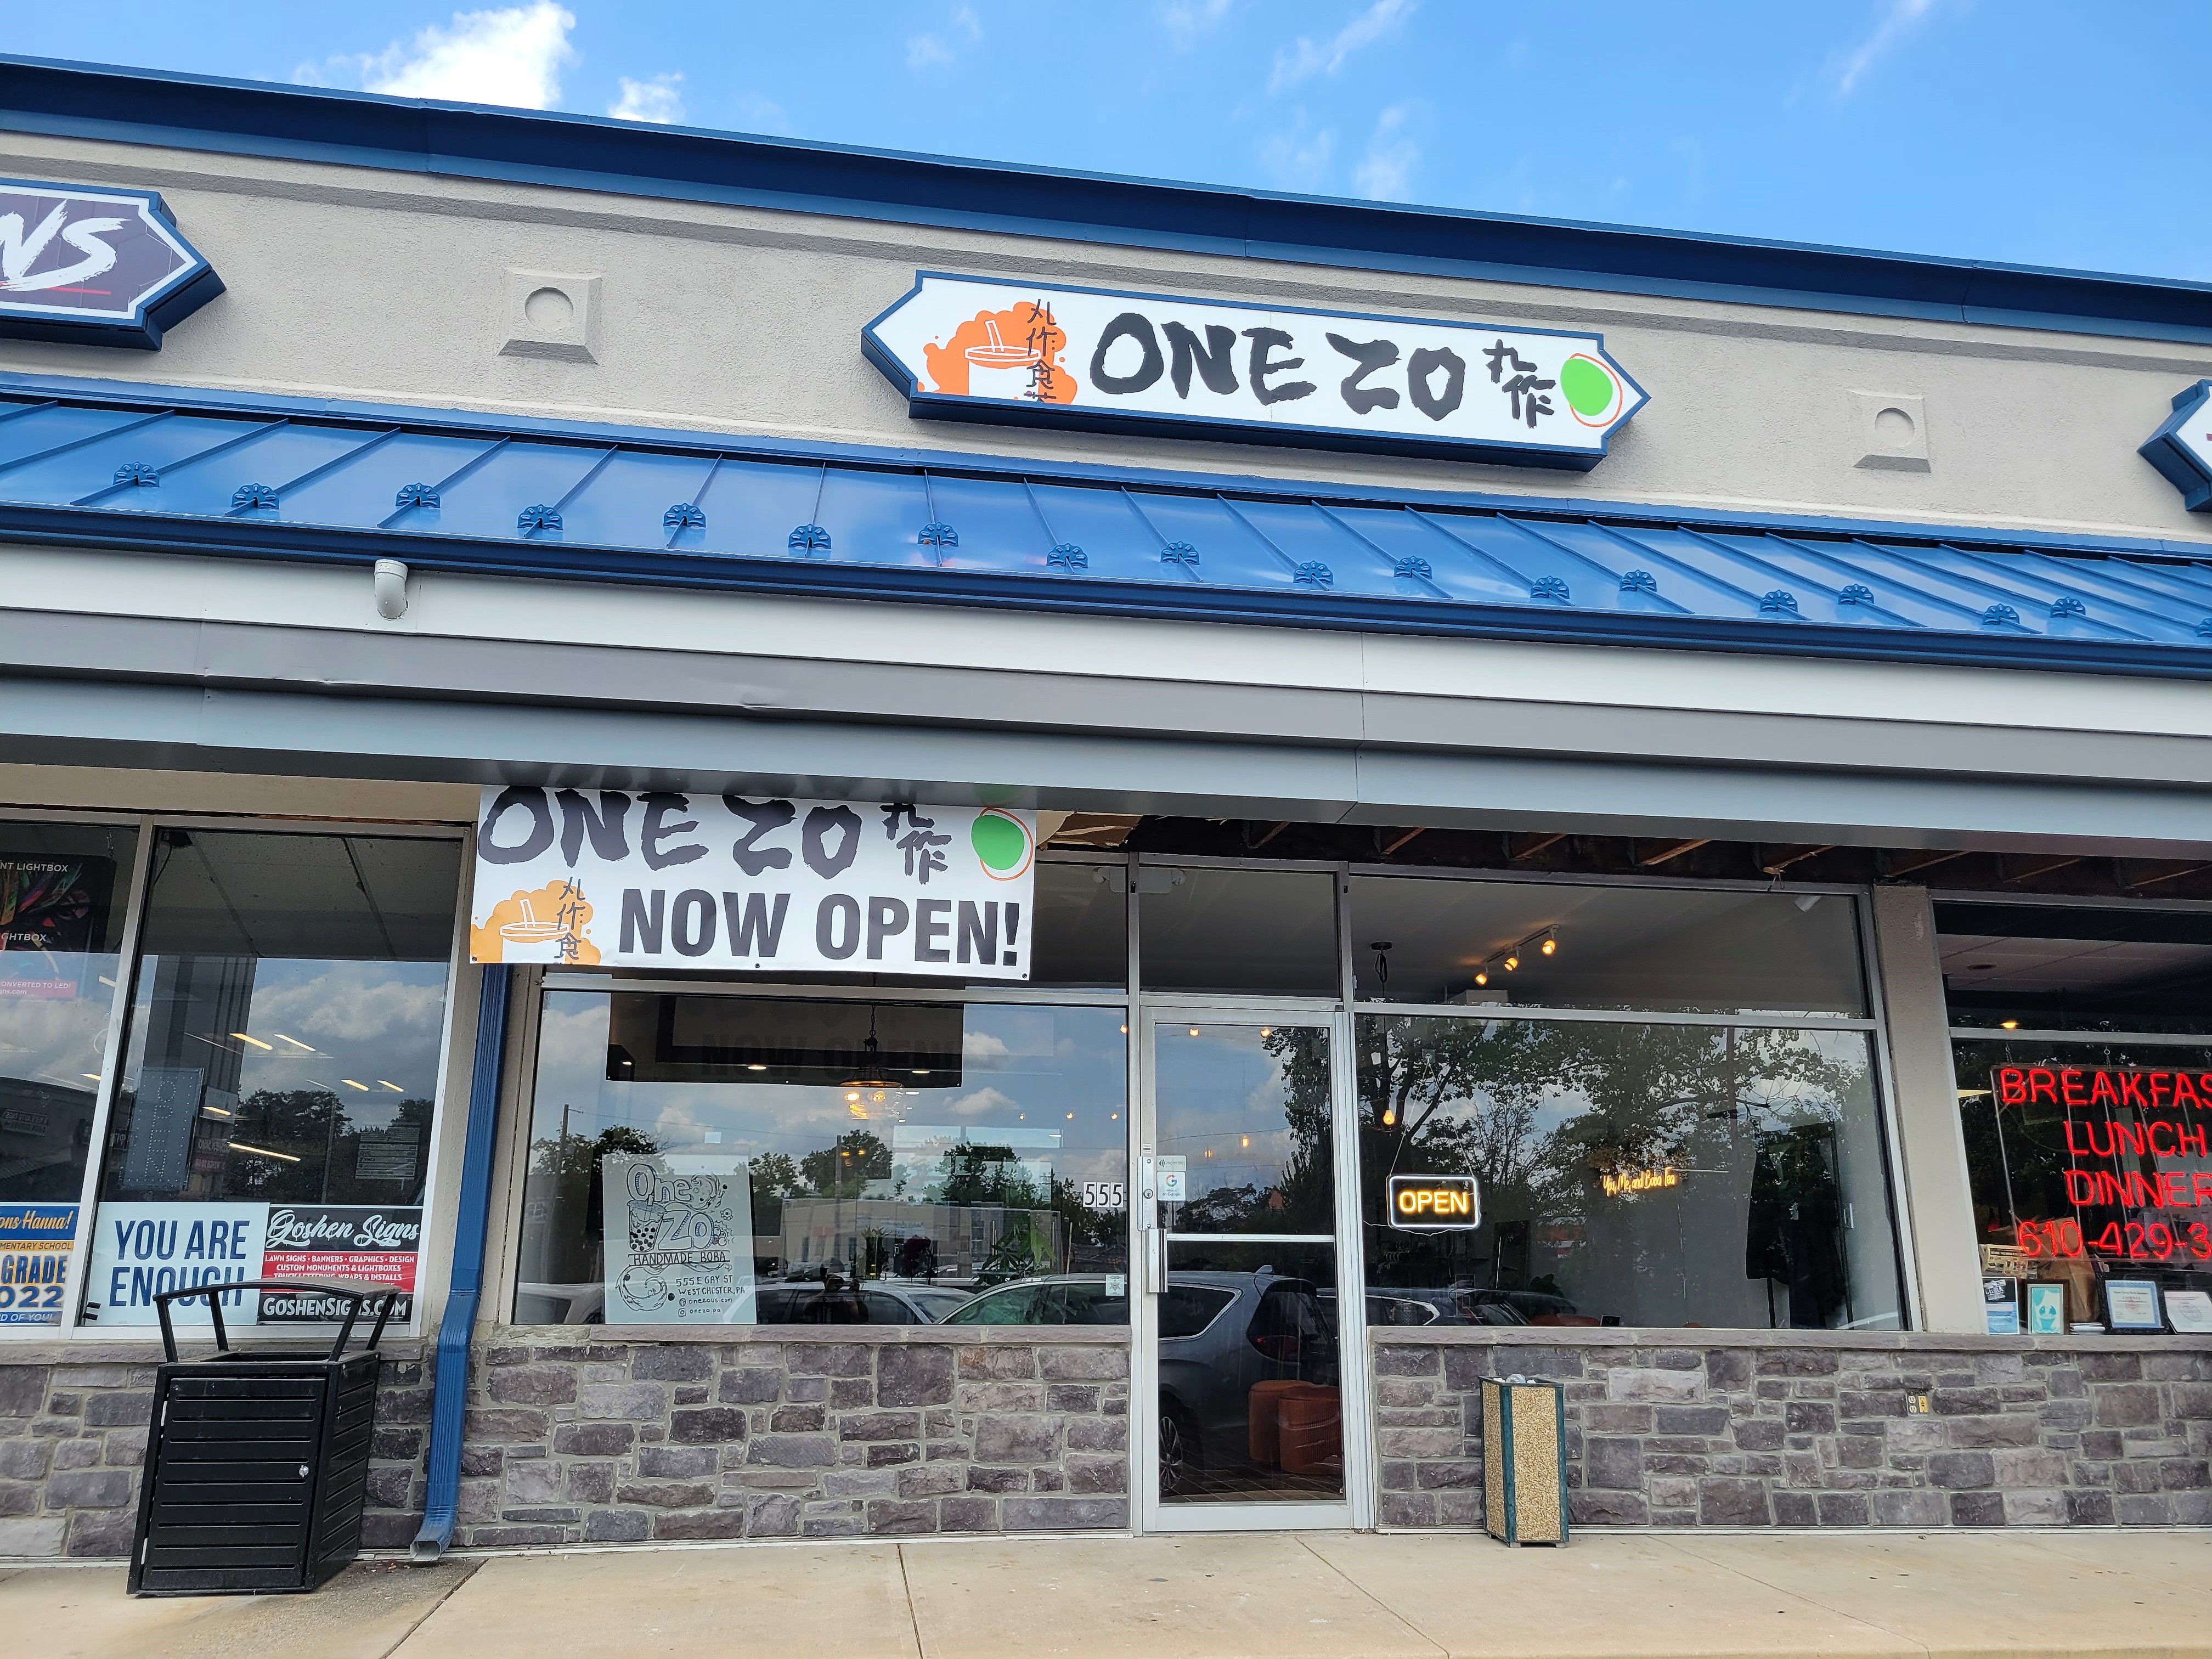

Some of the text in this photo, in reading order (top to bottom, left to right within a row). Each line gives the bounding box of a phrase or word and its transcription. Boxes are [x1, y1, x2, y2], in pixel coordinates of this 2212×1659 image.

[16, 863, 69, 872] LIGHTBOX
[619, 889, 1019, 966] NOW OPEN!
[2063, 1121, 2207, 1157] LUNCH
[627, 1163, 692, 1201] One
[1632, 1171, 1644, 1189] and
[1664, 1166, 1675, 1187] Tea
[2063, 1170, 2212, 1207] DINNER
[1085, 1183, 1122, 1206] 555
[1399, 1191, 1468, 1213] OPEN
[22, 1210, 74, 1229] Hanna!
[266, 1209, 420, 1249] Goshen Signs
[115, 1220, 250, 1260] YOU ARE
[2, 1255, 67, 1284] GRADE
[633, 1251, 726, 1265] HANDMADE BOBA
[675, 1277, 695, 1287] 555
[704, 1275, 720, 1284] GAY
[724, 1274, 732, 1283] ST
[0, 1313, 8, 1322] D
[263, 1297, 407, 1316] GOSHENSIGS.CM
